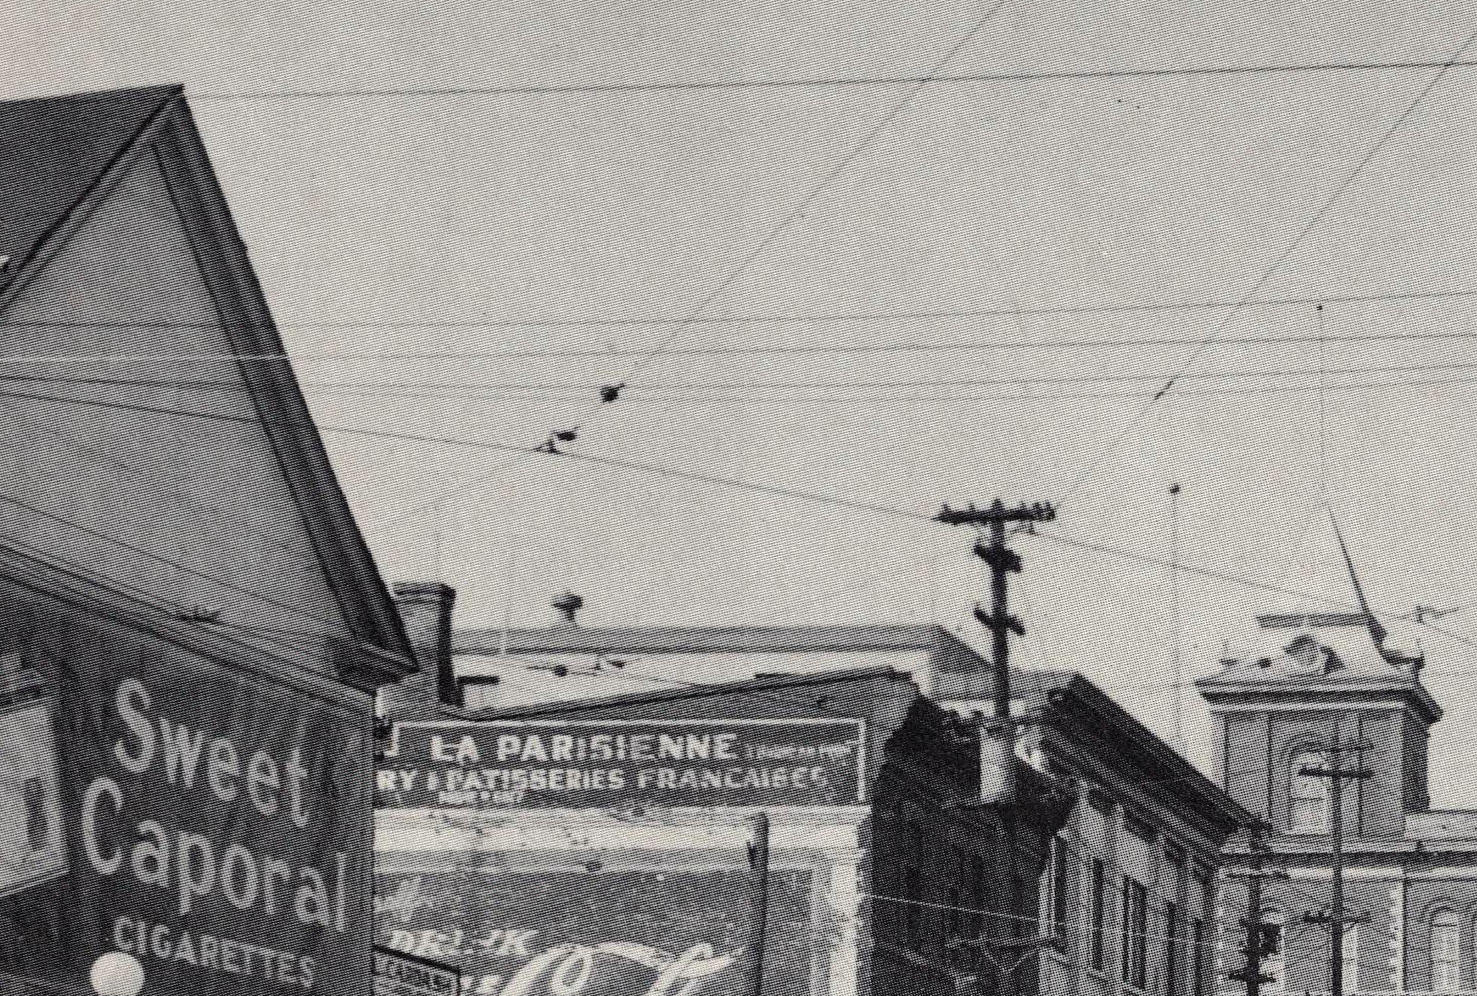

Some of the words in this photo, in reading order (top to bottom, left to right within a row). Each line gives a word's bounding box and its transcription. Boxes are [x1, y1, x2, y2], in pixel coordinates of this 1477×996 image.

[114, 677, 311, 828] Sweet
[431, 734, 480, 763] LA
[497, 732, 740, 762] PARISIENNE
[446, 767, 626, 791] PATISSERIES
[81, 775, 348, 932] Caporal
[113, 914, 316, 989] CIGARETTES
